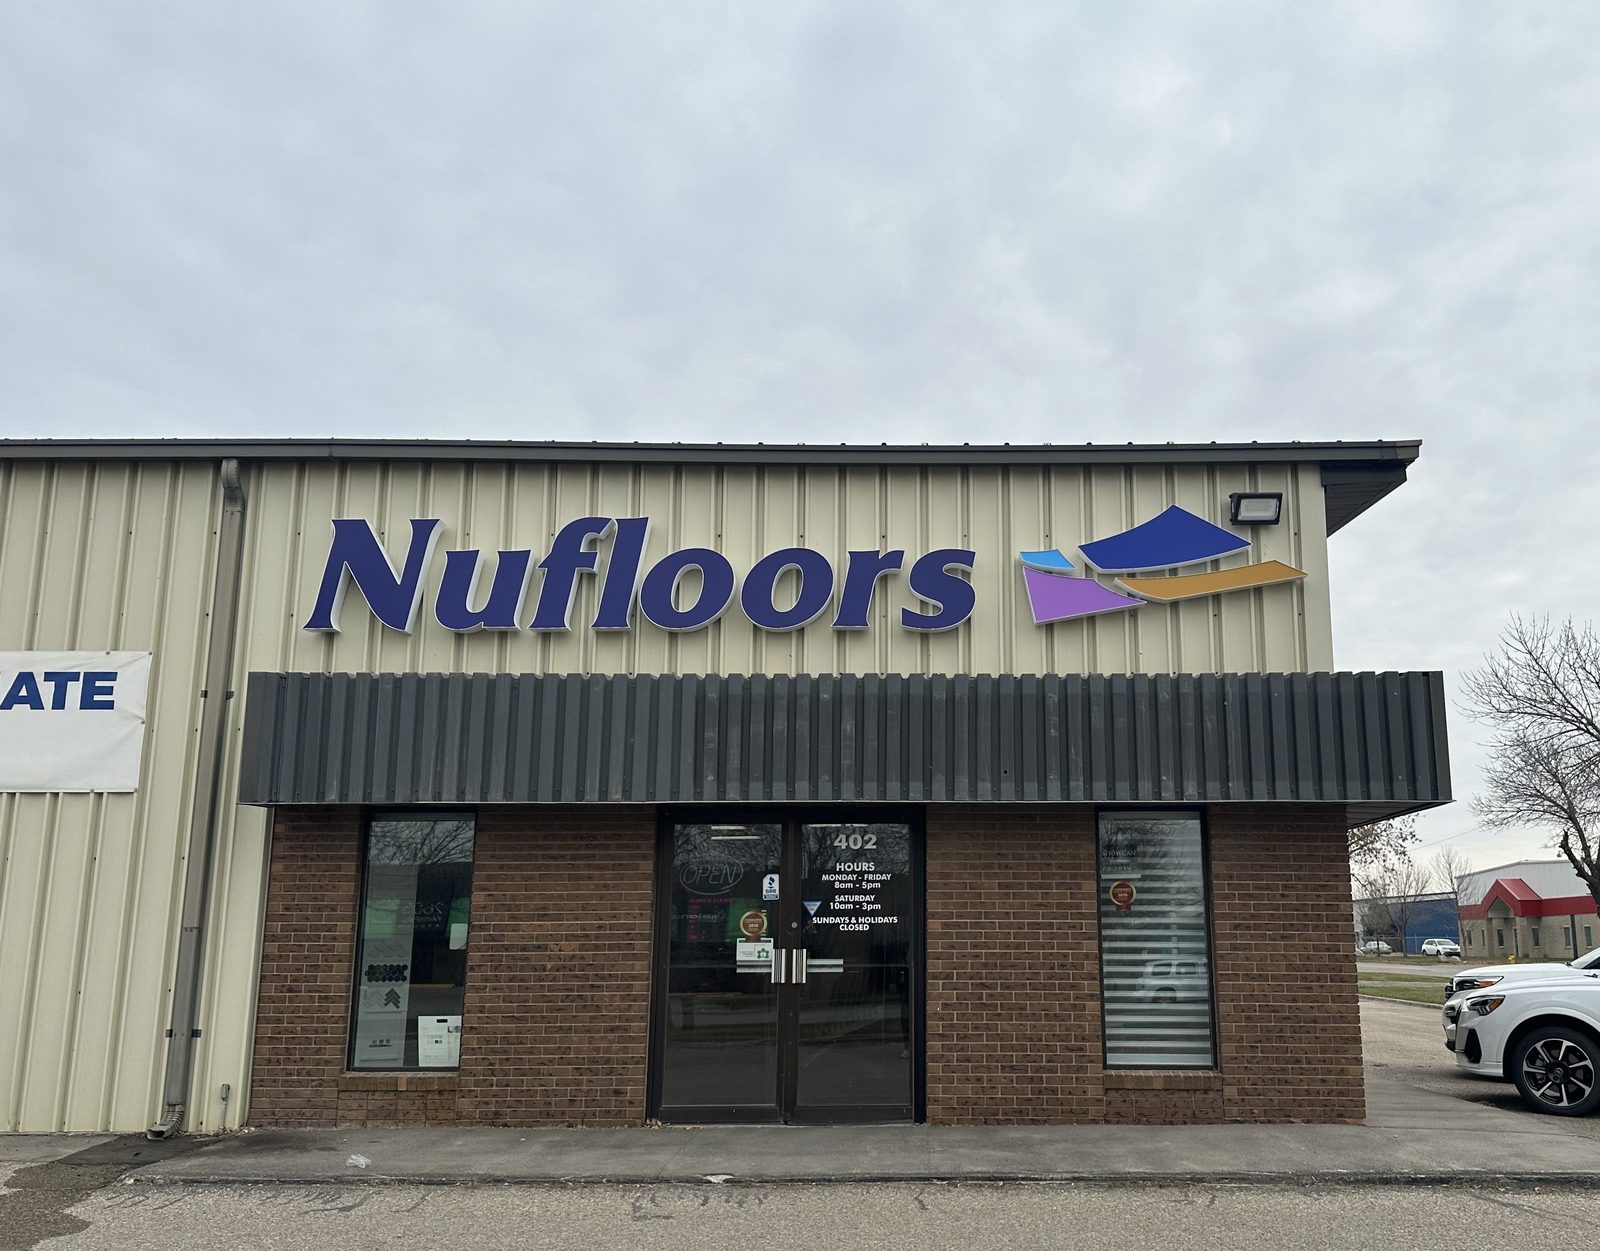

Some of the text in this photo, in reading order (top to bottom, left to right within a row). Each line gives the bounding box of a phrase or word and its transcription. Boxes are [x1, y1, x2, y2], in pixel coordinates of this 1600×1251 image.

[302, 516, 977, 633] Nufloors
[0, 671, 118, 710] ATE
[833, 833, 877, 850] 402
[836, 862, 875, 872] HOURS
[683, 863, 738, 885] OPEN
[864, 873, 892, 881] FRIDAY
[834, 881, 854, 889] 8am
[861, 881, 881, 890] 5pm
[834, 894, 876, 902] SATURDAY
[829, 902, 854, 910] 10am
[861, 902, 881, 911] 3pm
[812, 916, 850, 924] SUNDAYS
[858, 916, 898, 924] HOLIDAYS
